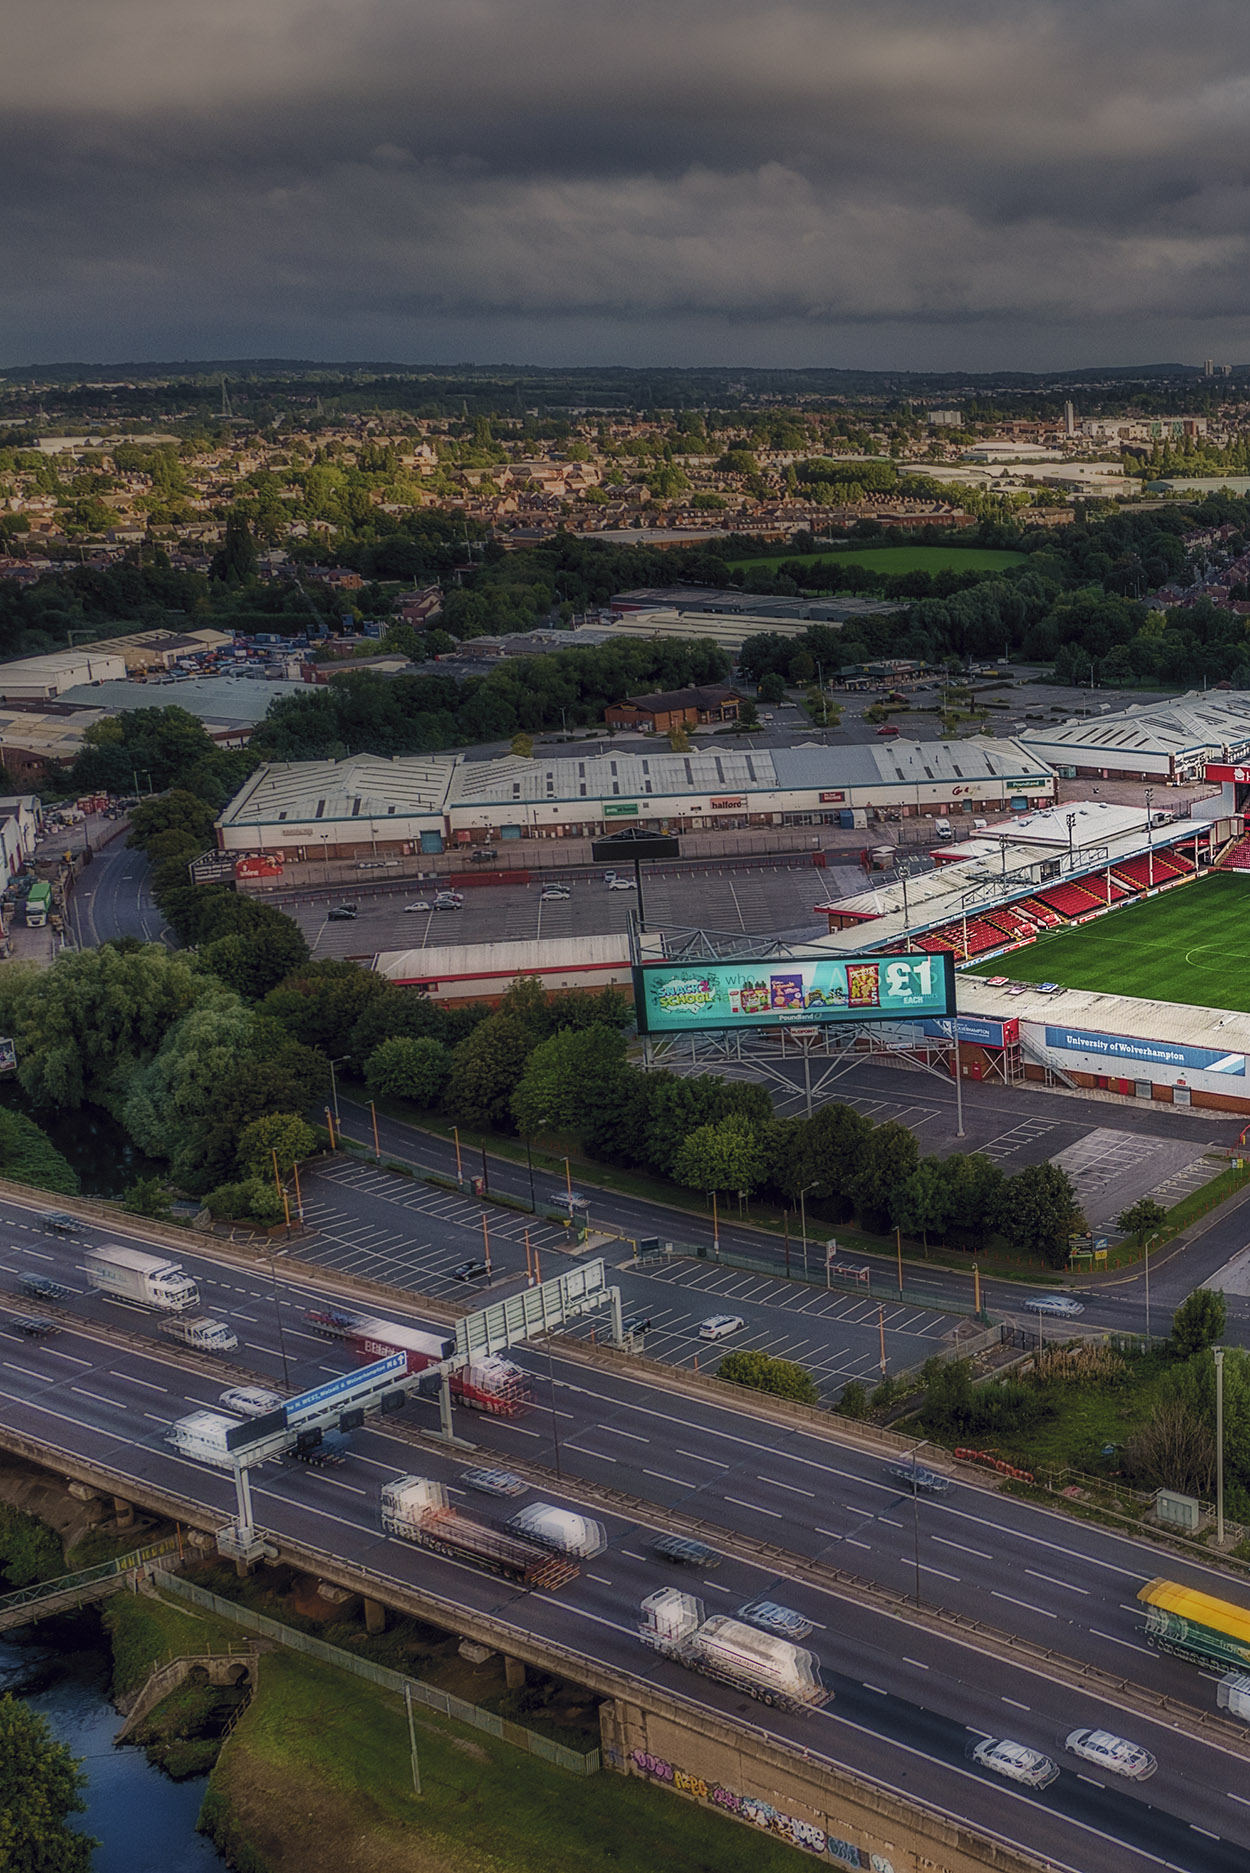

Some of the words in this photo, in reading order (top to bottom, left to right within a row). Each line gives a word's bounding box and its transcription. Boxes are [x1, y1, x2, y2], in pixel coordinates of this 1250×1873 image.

[886, 961, 932, 996] £1
[658, 983, 702, 998] SNACK
[700, 980, 711, 992] 2
[659, 991, 713, 1007] SCHOOL
[903, 996, 924, 1004] EACH
[778, 1013, 814, 1021] Poundland
[1066, 1035, 1108, 1051] University
[1109, 1042, 1119, 1051] of
[1119, 1044, 1185, 1061] Wolverhampton
[346, 1365, 386, 1386] Wolverhampton
